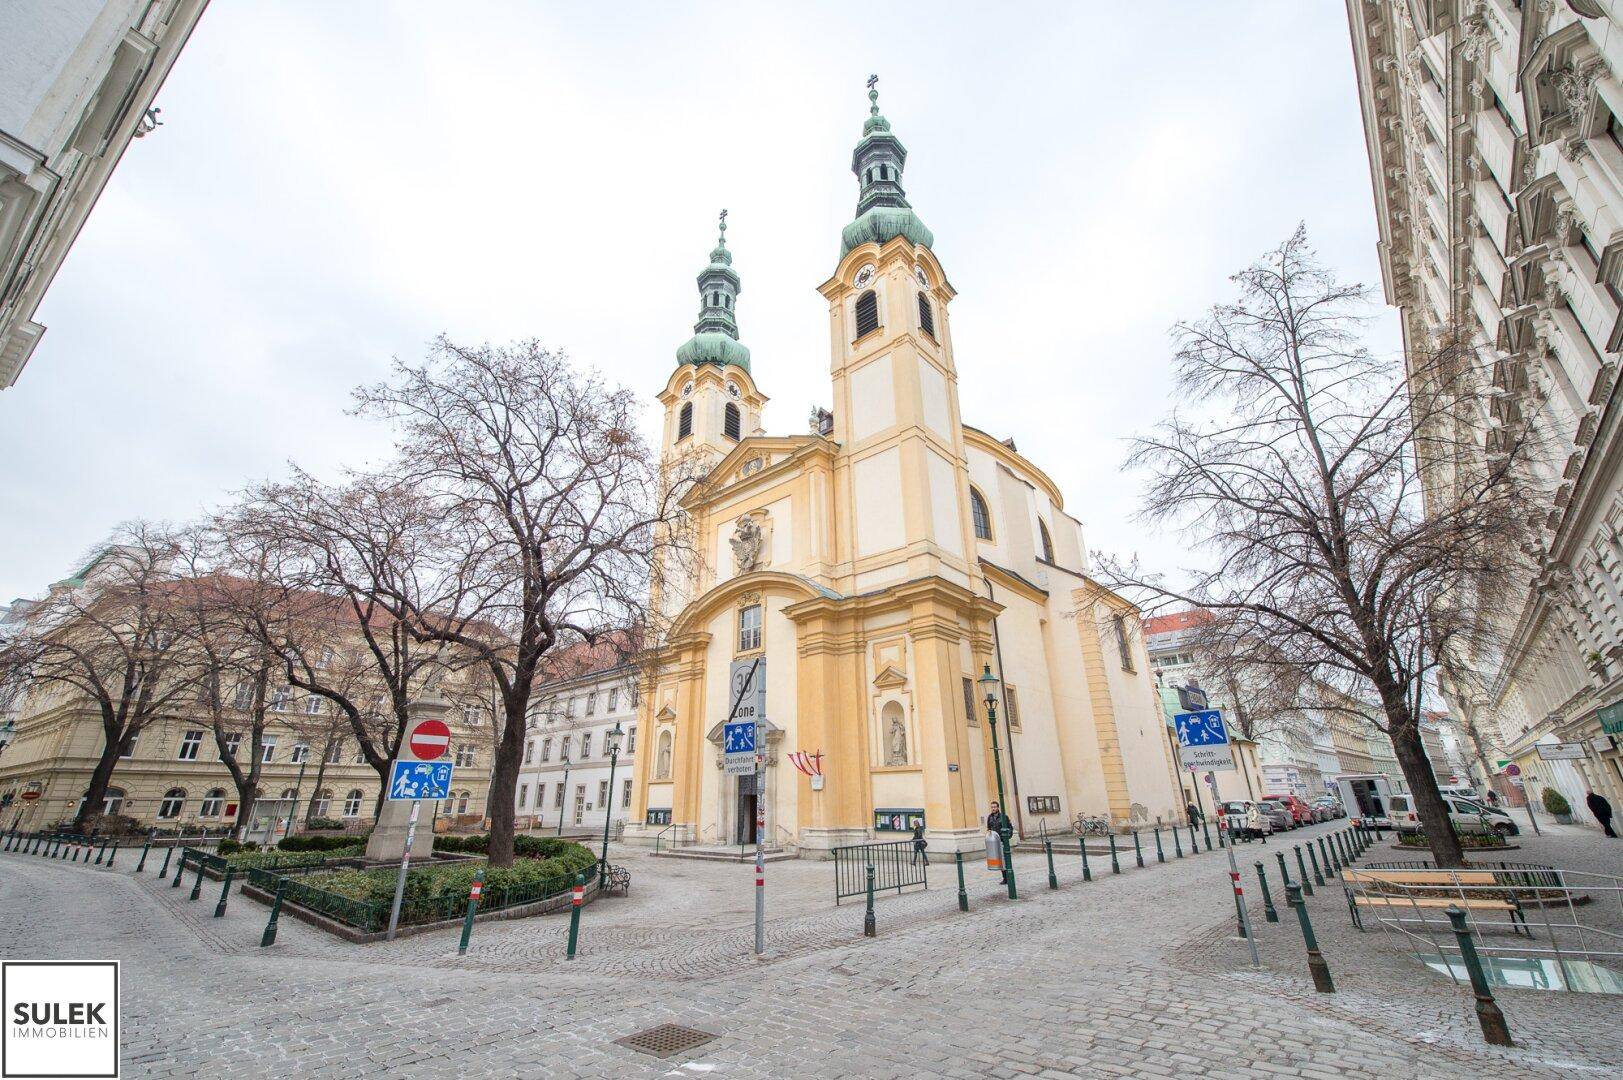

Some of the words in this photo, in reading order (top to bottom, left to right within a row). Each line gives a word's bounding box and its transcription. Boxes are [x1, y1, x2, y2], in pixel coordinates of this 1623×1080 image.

[736, 672, 752, 695] 30
[725, 757, 754, 765] Durchfahrt
[727, 764, 752, 774] verboten
